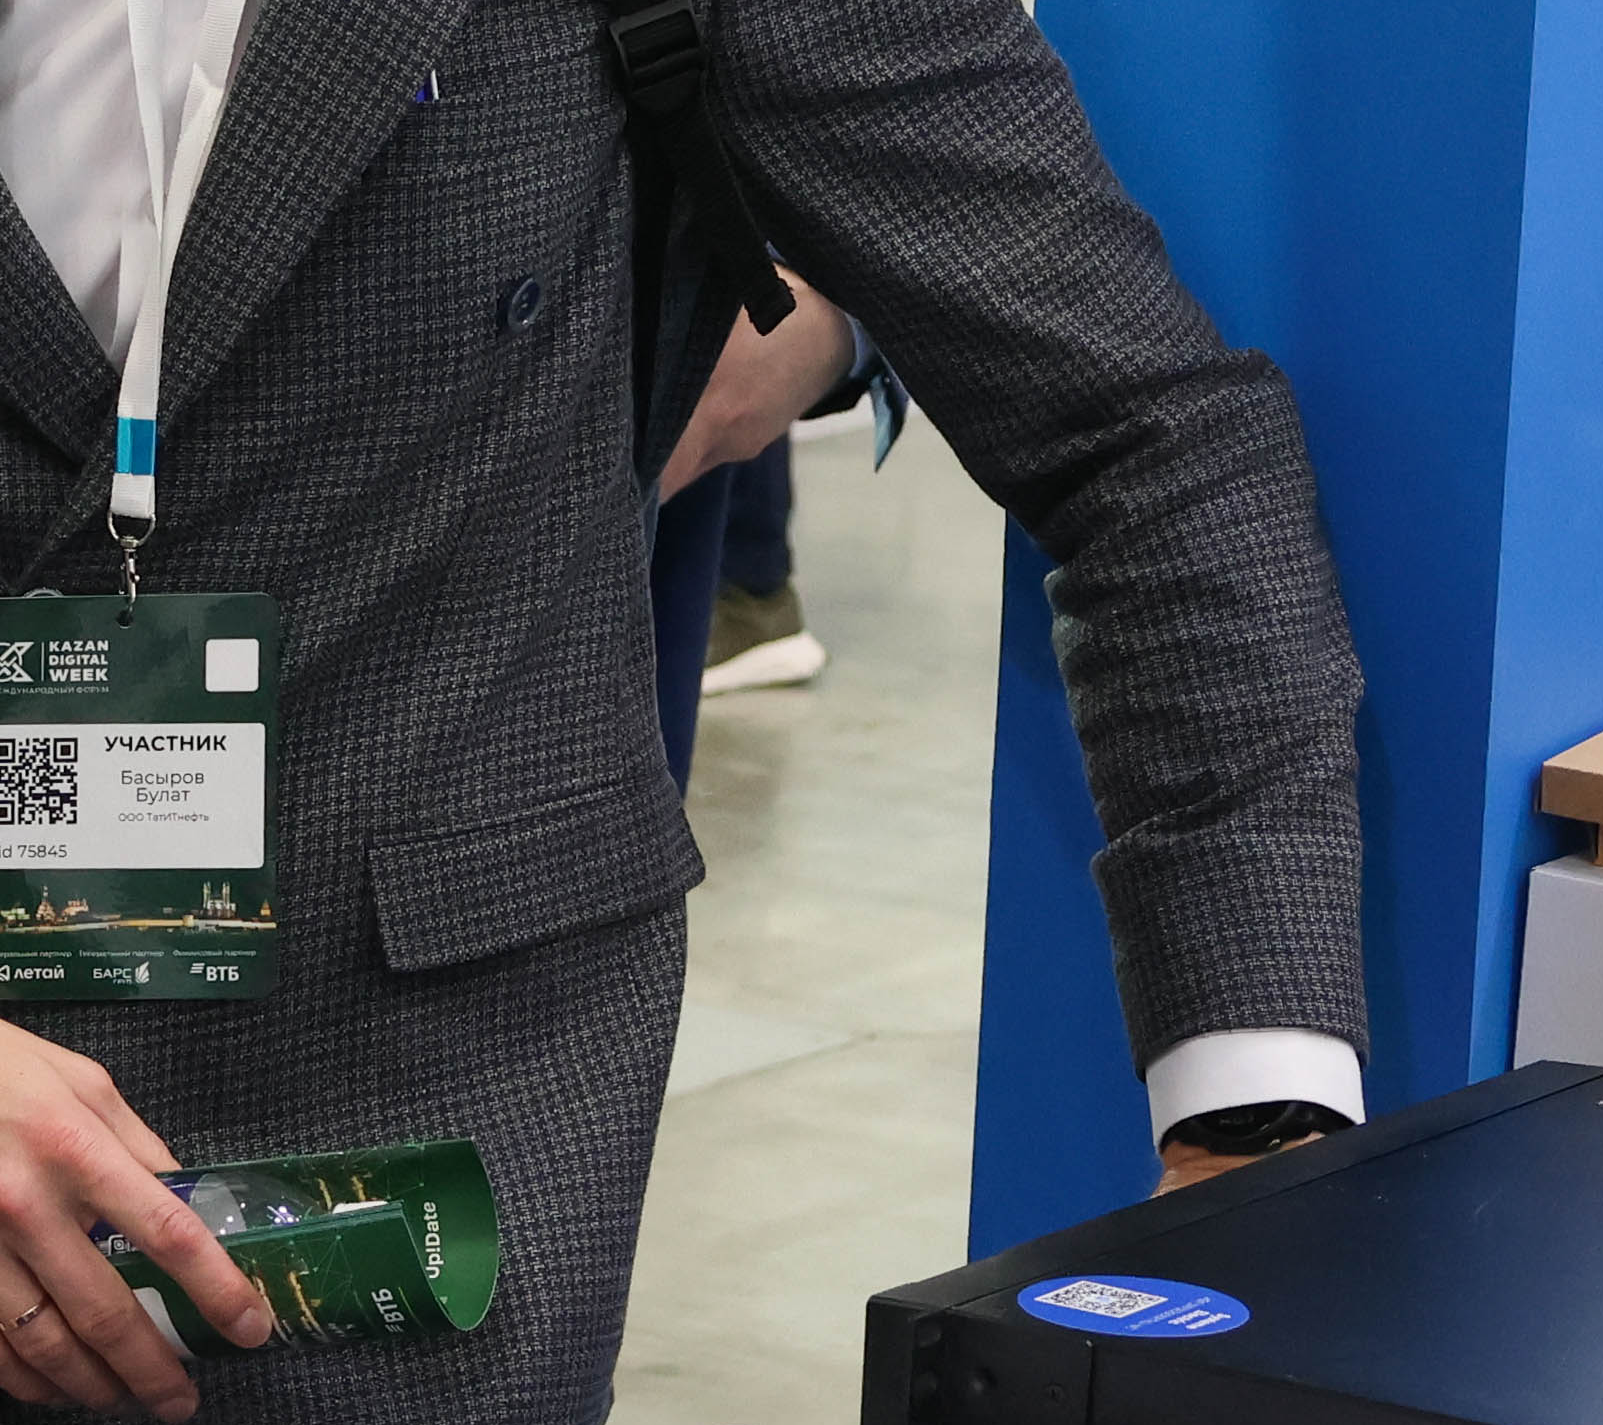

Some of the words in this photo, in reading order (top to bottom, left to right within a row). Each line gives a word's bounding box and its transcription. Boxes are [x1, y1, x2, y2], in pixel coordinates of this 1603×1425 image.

[48, 640, 109, 652] KAZAN
[48, 654, 109, 666] DIGITAL
[48, 668, 109, 682] WEEK
[104, 735, 227, 752] УЧАСТНИК
[121, 770, 205, 787] Басыров
[136, 787, 191, 805] Булат
[118, 813, 144, 822] ООО
[17, 845, 68, 859] 75845
[14, 965, 65, 981] летай
[93, 968, 132, 980] БАРС
[206, 966, 240, 982] ВТБ
[423, 1201, 444, 1280] Up!Date
[371, 1287, 406, 1328] ВТБ
